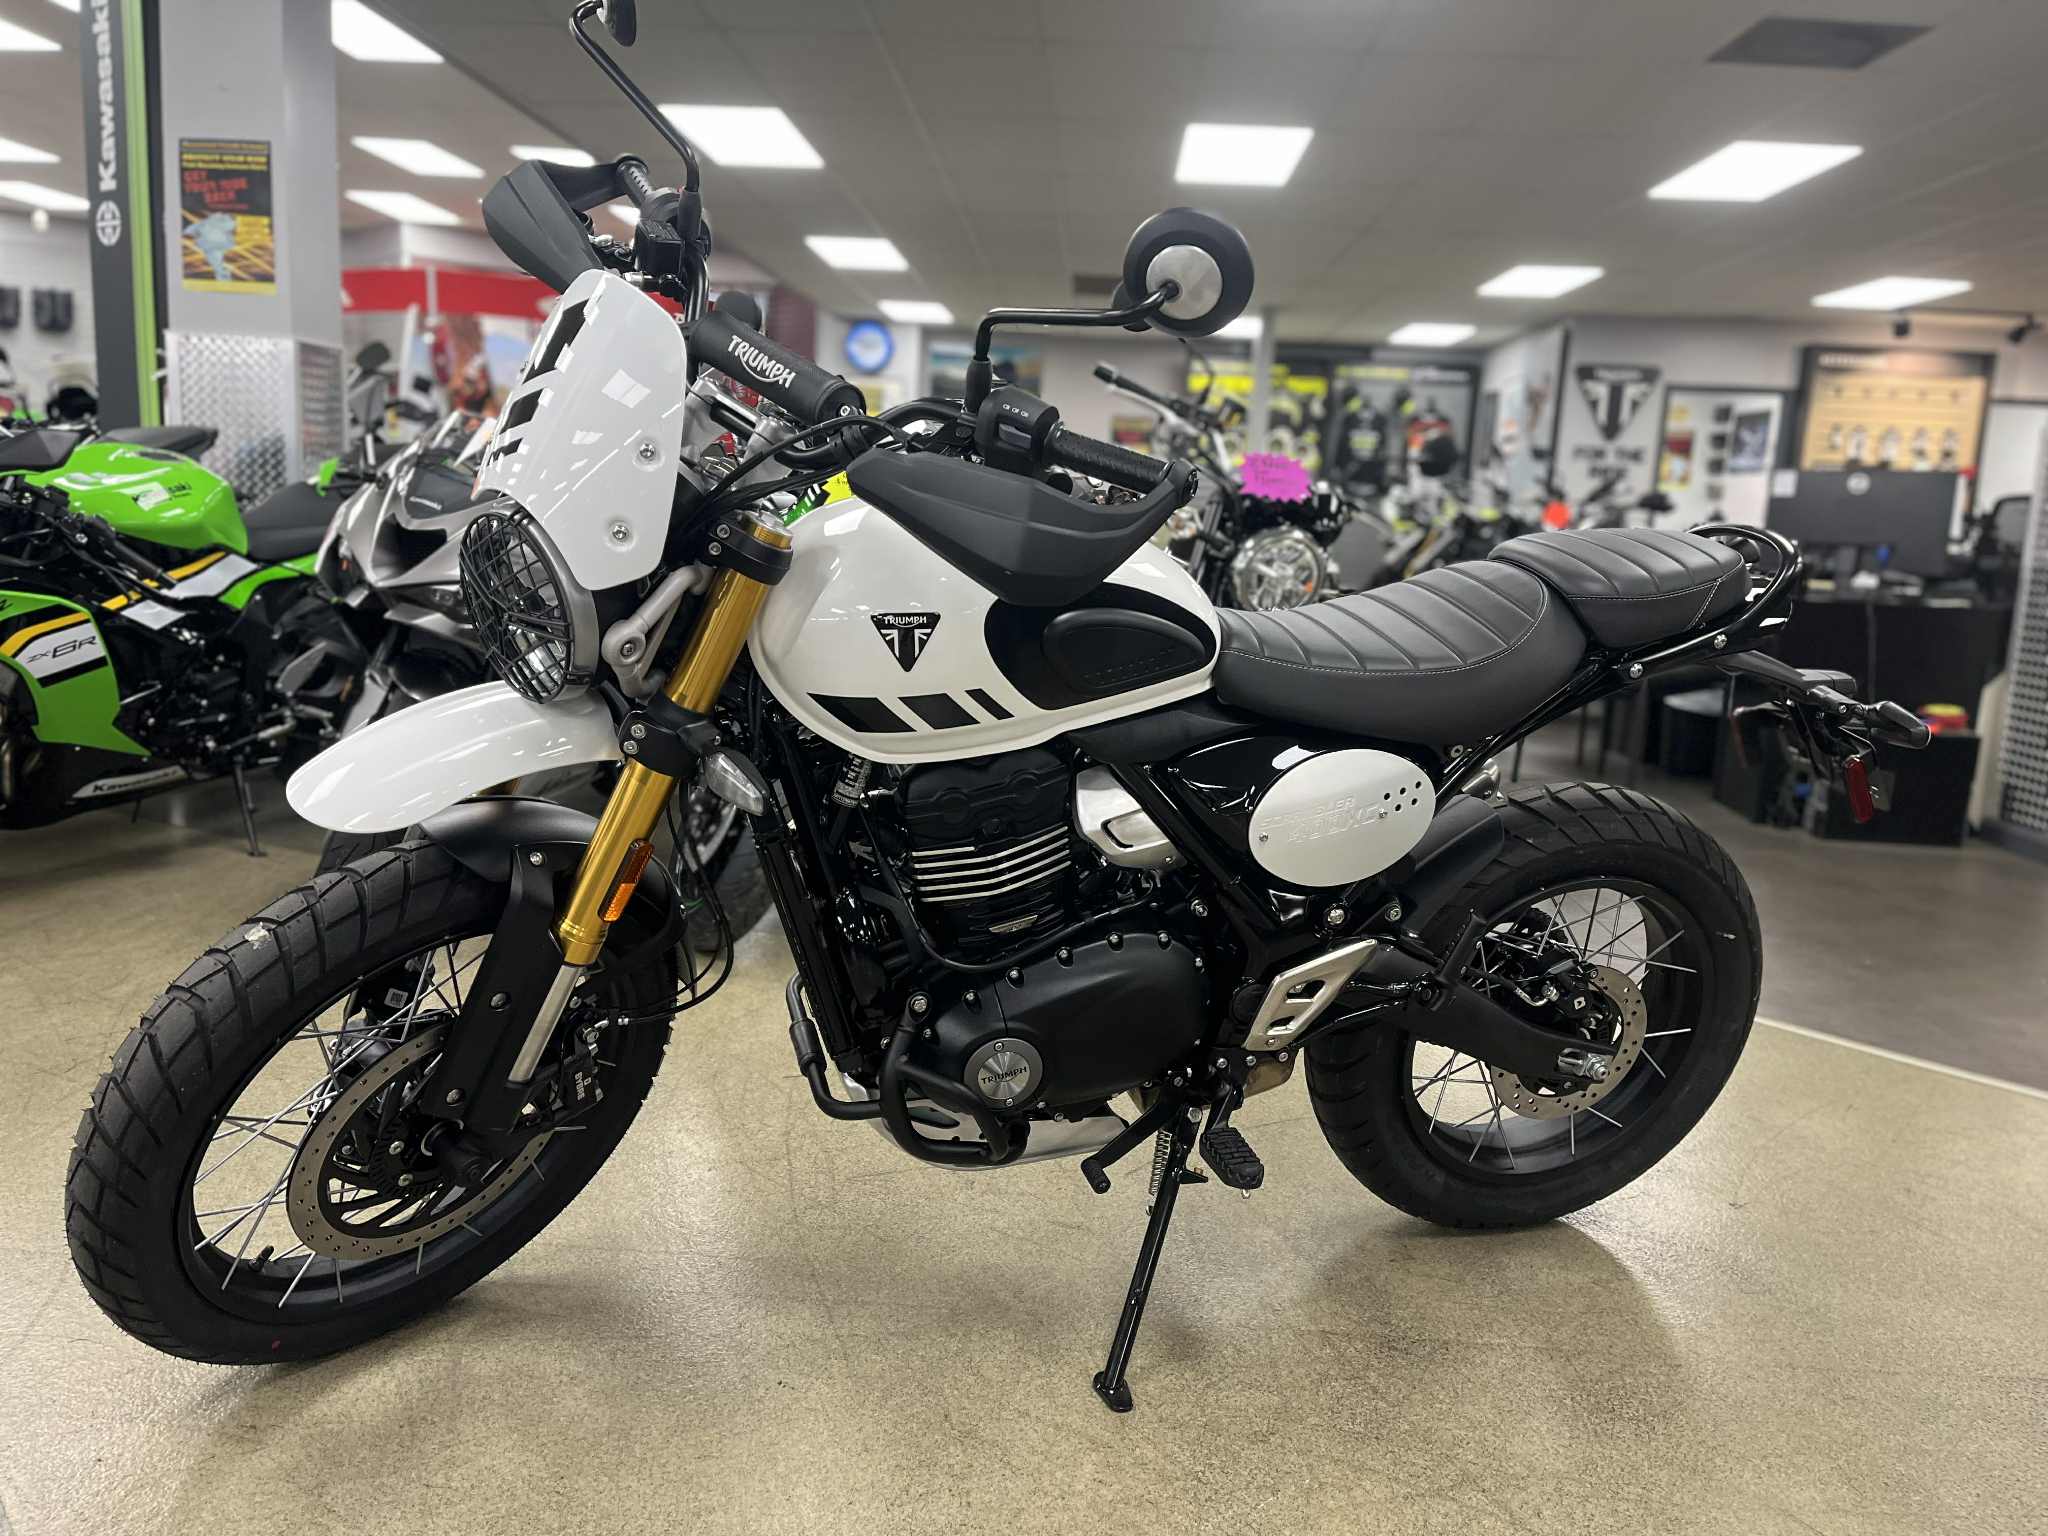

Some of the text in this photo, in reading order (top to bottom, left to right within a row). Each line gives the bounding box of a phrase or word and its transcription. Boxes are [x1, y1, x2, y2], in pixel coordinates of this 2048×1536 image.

[727, 334, 797, 389] TRIUMPH
[883, 615, 927, 625] TRIUMPH
[981, 1066, 1027, 1085] TRIUMPH
